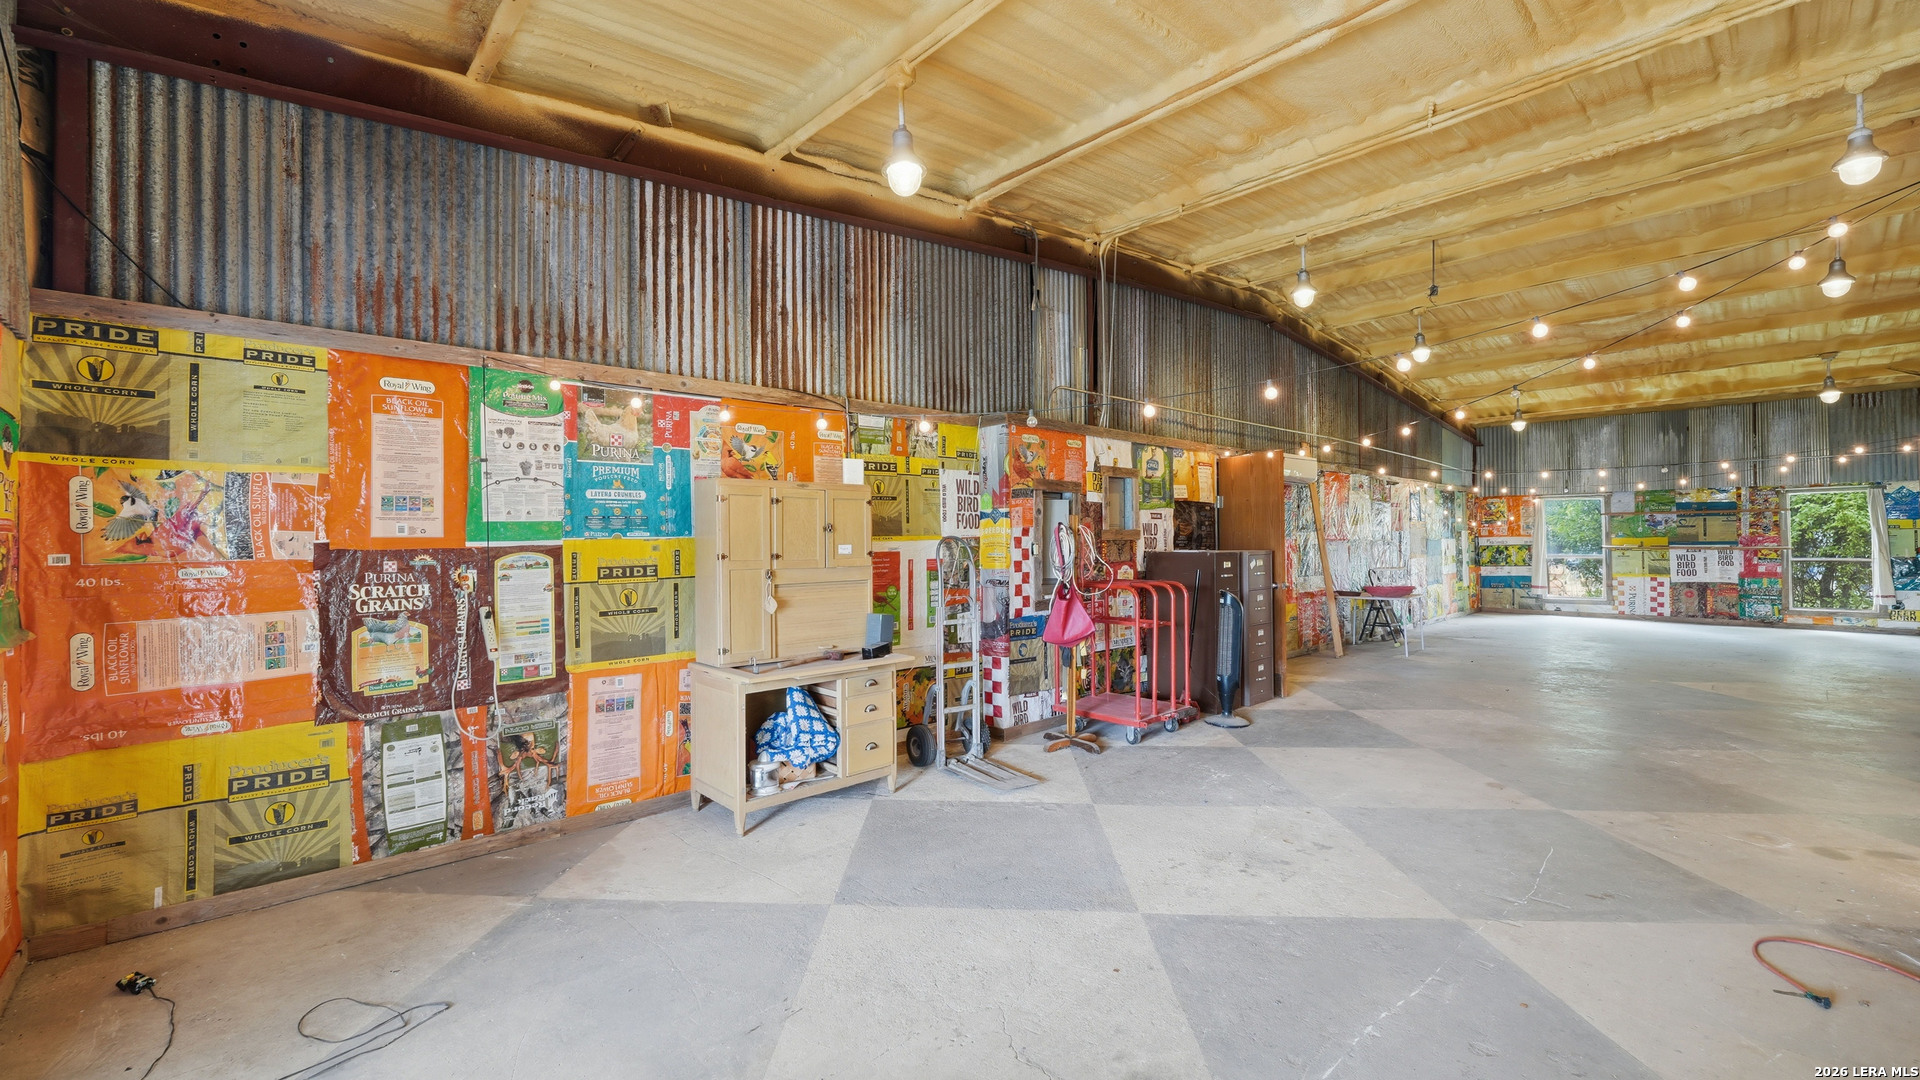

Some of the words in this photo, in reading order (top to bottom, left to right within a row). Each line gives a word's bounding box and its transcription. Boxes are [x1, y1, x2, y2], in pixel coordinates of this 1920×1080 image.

[36, 320, 154, 346] PRIDE
[246, 350, 314, 366] PRIDE
[52, 382, 99, 393] WHOLE
[104, 387, 138, 396] CORN
[190, 374, 198, 398] CORN
[383, 379, 405, 390] Royal
[411, 382, 432, 394] Wing
[386, 397, 413, 406] BLACK
[414, 400, 429, 409] OIL
[533, 393, 548, 402] Mix
[190, 401, 198, 432] WHOLE
[382, 403, 434, 415] SUNFLOWER
[664, 410, 673, 438] PURINA
[592, 444, 639, 460] PURINA
[789, 440, 796, 450] 40
[50, 455, 96, 463] WHOLE
[592, 466, 640, 480] PREMIUM
[76, 480, 91, 501] Wing
[252, 473, 263, 511] SUNFLO
[956, 479, 980, 495] WILD
[957, 496, 979, 513] BIRD
[76, 508, 90, 530] Royal
[252, 513, 262, 528] OIL
[956, 513, 980, 530] FOOD
[1142, 522, 1158, 536] WILD
[253, 529, 266, 559] BLACK
[1144, 536, 1158, 550] BIRD
[1676, 554, 1696, 562] WILD
[363, 572, 415, 584] PURINA
[599, 566, 657, 578] PRIDE
[1676, 569, 1698, 577] FOOD
[76, 578, 97, 588] 40
[101, 577, 125, 587] lbs.
[349, 584, 431, 600] SCRATCH
[355, 597, 424, 613] GRAINS
[1010, 628, 1037, 636] PRIDE
[77, 637, 91, 659] Wing
[108, 637, 118, 654] OIL
[119, 632, 131, 685] SUNFLOWER
[77, 664, 91, 687] Royal
[108, 658, 118, 682] BLACK
[358, 711, 389, 720] SCRATCH
[391, 706, 418, 716] GRAINS
[1012, 700, 1029, 714] WILD
[79, 733, 103, 742] lbs.
[107, 730, 128, 739] 40
[229, 753, 330, 778] Producer's
[184, 766, 193, 800] PRIDE
[231, 767, 327, 793] PRIDE
[516, 793, 546, 806] Rack
[610, 788, 631, 798] BLACK
[50, 801, 135, 826] PRIDE
[502, 800, 546, 816] Record
[188, 821, 196, 851] WHOLE
[245, 831, 282, 841] WHOLE
[286, 824, 315, 834] CORN
[188, 855, 196, 879] CORN
